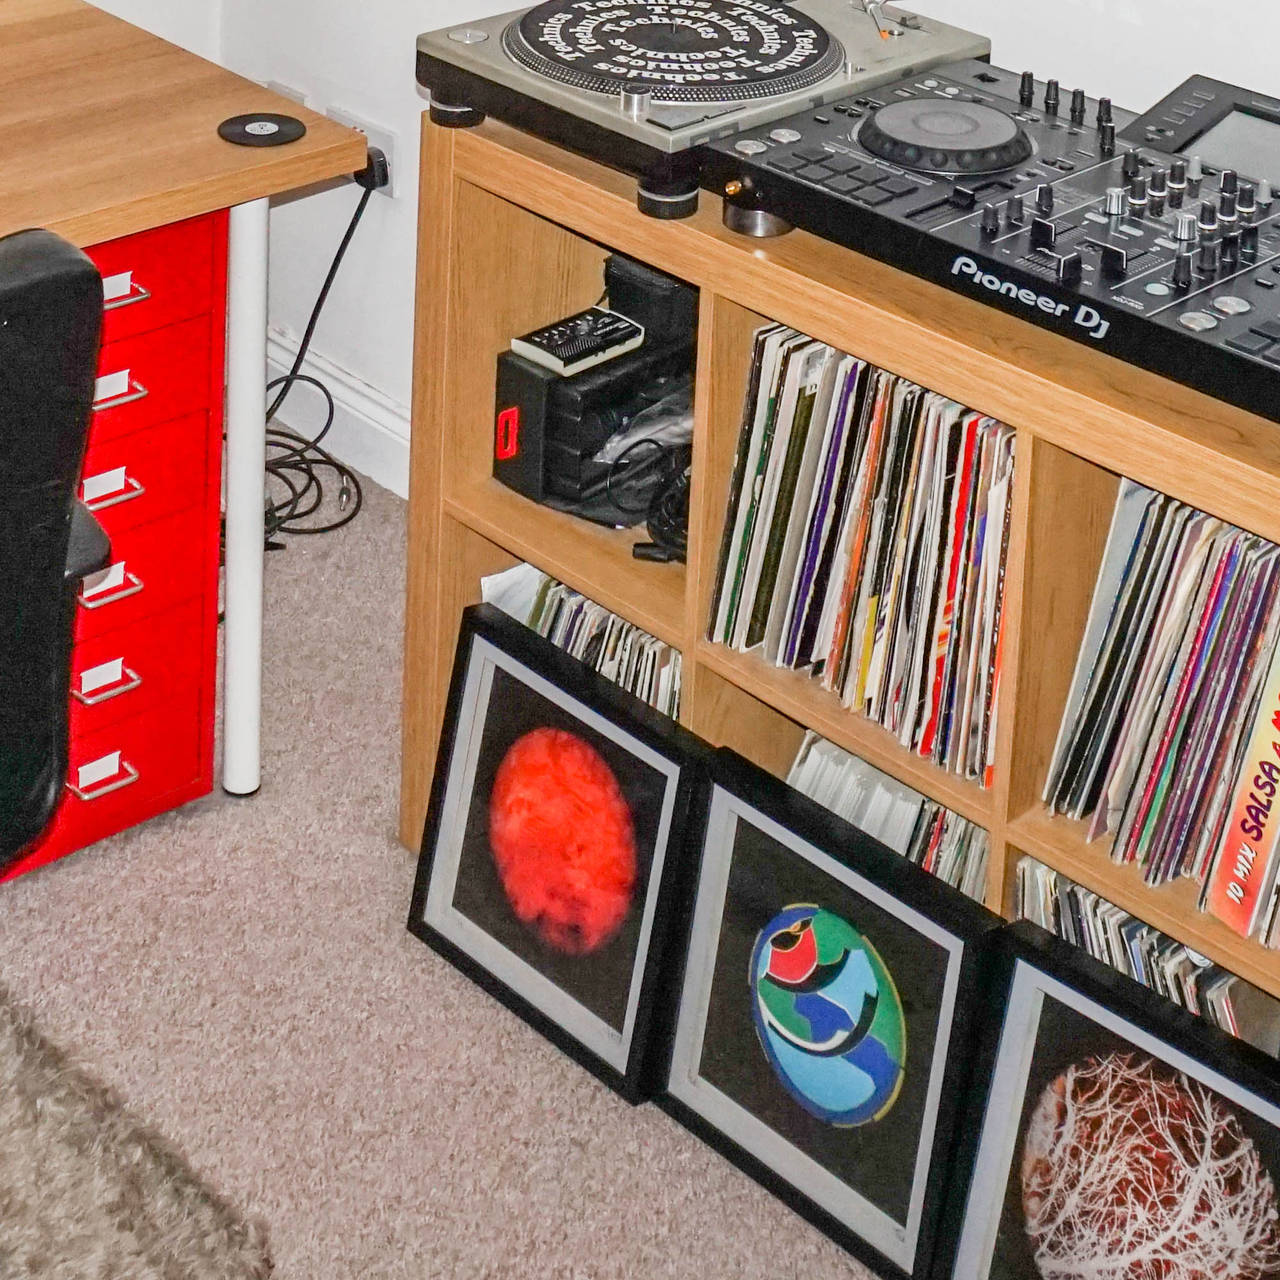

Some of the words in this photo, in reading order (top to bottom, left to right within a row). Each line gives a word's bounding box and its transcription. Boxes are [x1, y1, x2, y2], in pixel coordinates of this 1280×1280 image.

[951, 256, 1070, 317] Pioneer
[1074, 305, 1111, 339] DJ
[1241, 760, 1280, 842] SALSA
